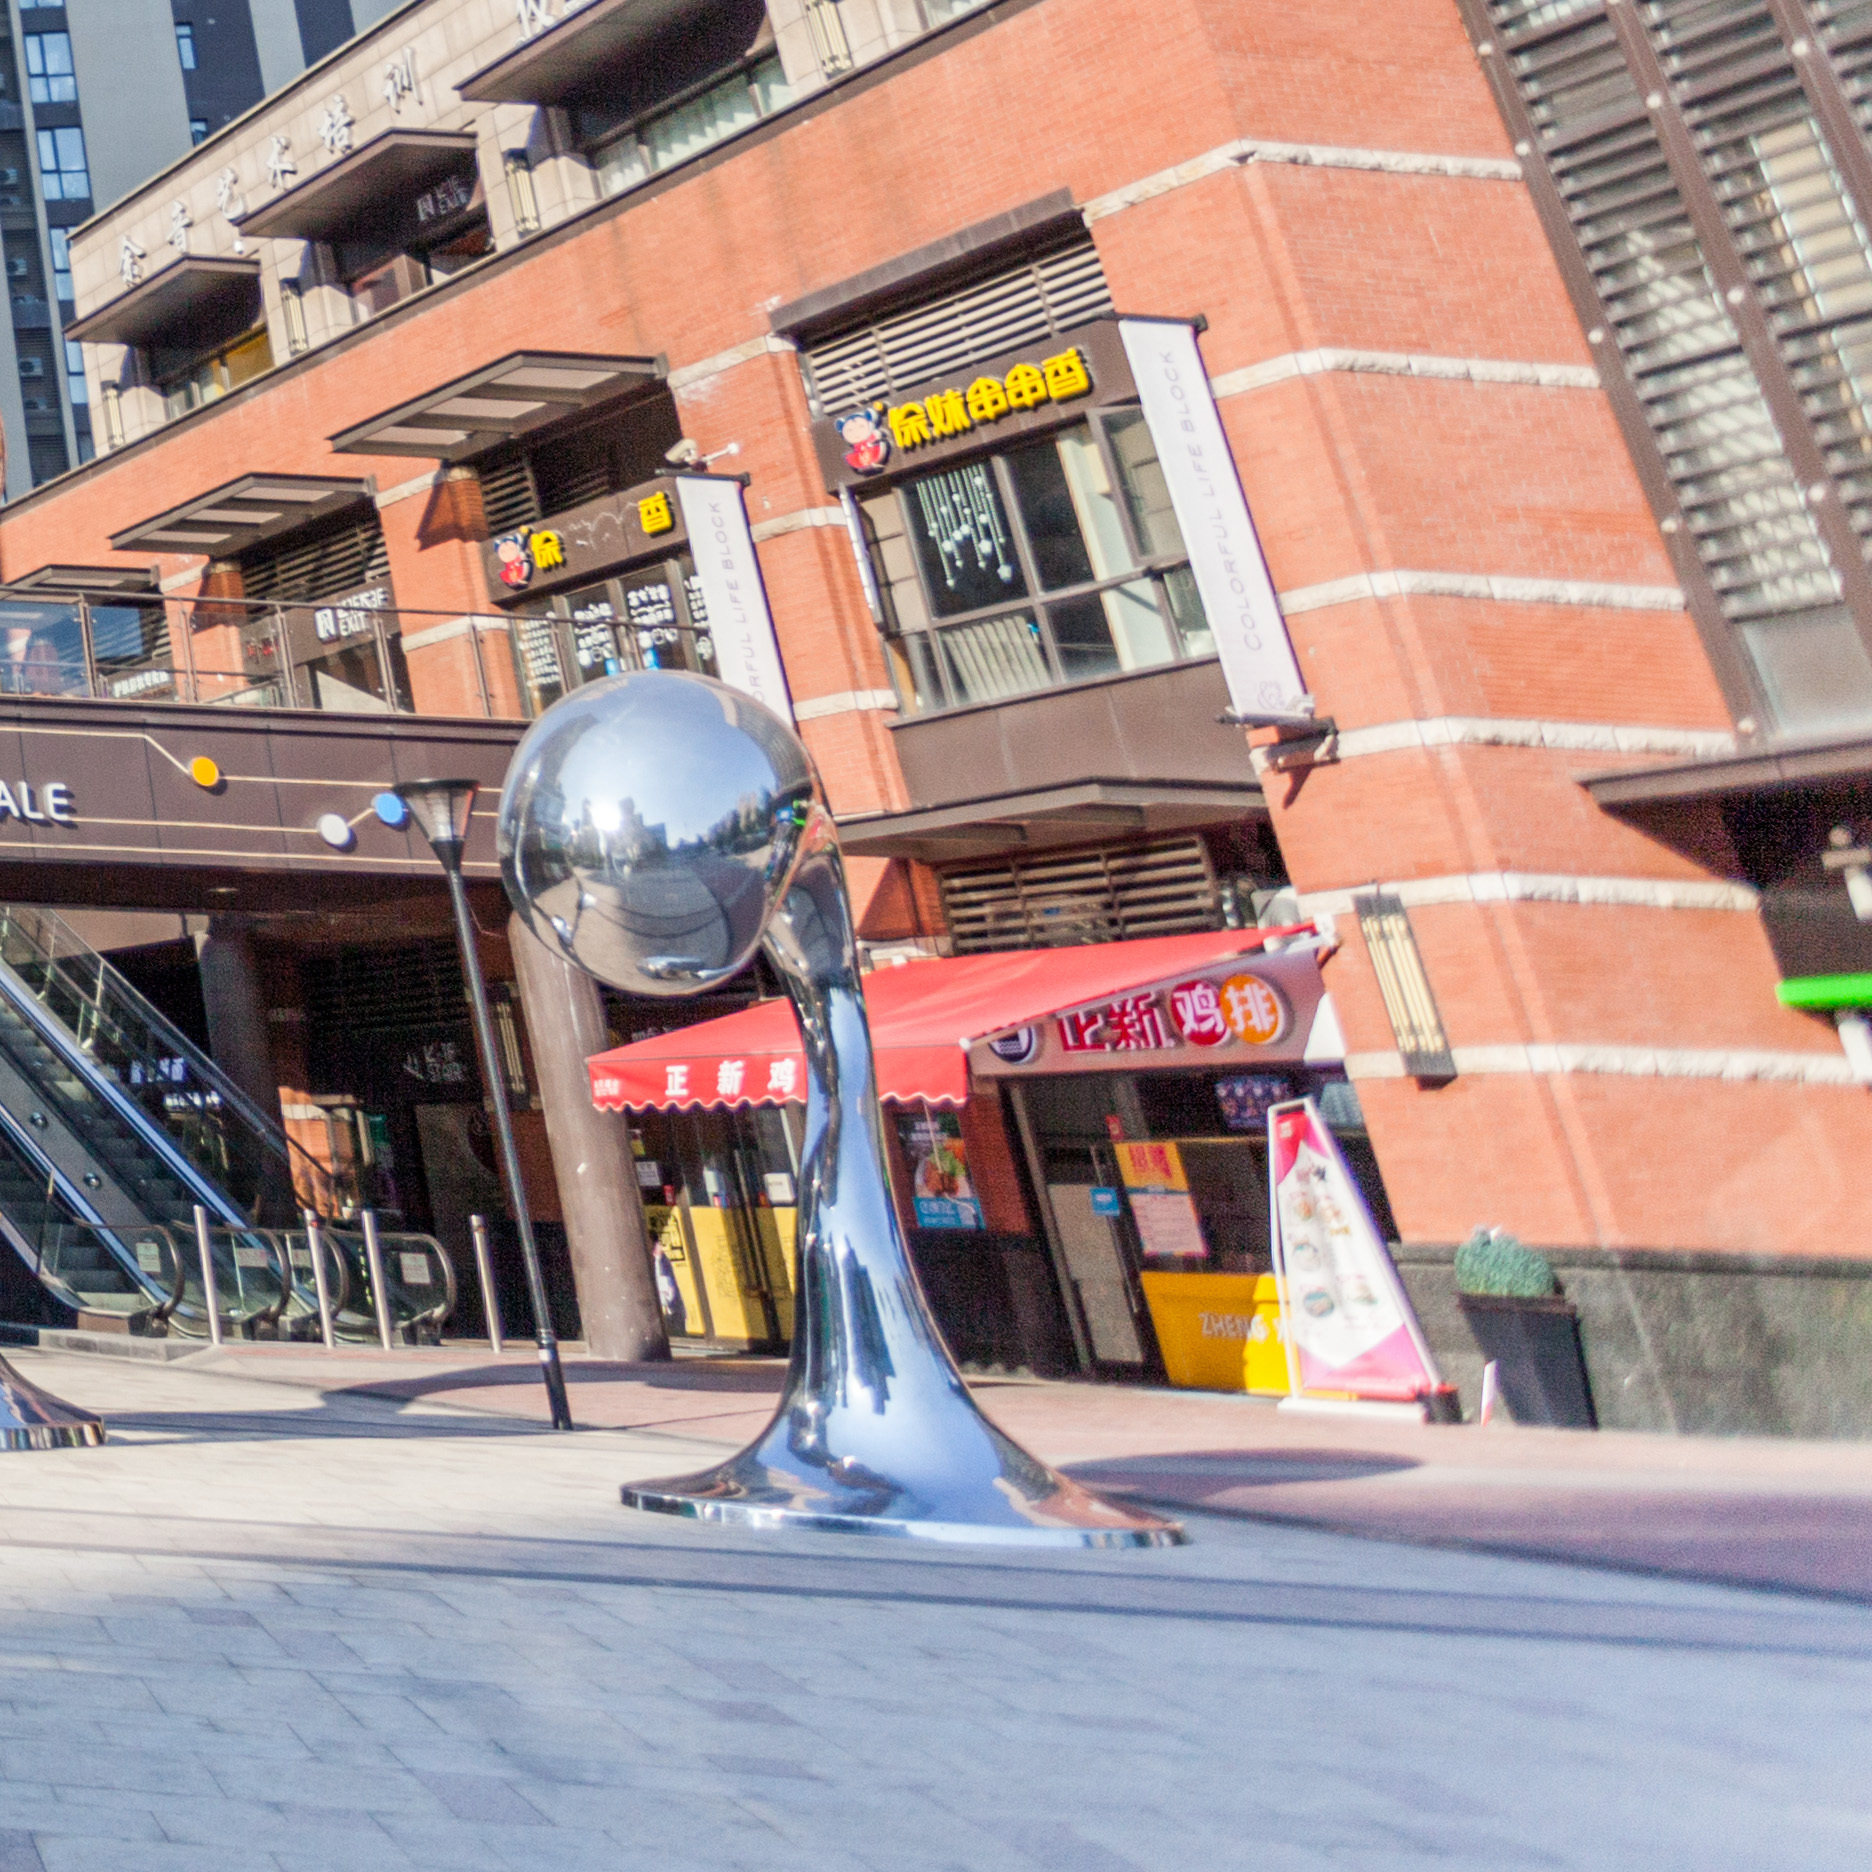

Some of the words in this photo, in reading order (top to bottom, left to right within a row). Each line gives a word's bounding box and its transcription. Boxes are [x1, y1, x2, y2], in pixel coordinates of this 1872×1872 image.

[1158, 348, 1199, 434] BLOCK
[1189, 439, 1218, 502] LIFE
[637, 490, 673, 534] 香
[1211, 510, 1264, 652] COLORFUL
[665, 1058, 797, 1096] 正新鸡
